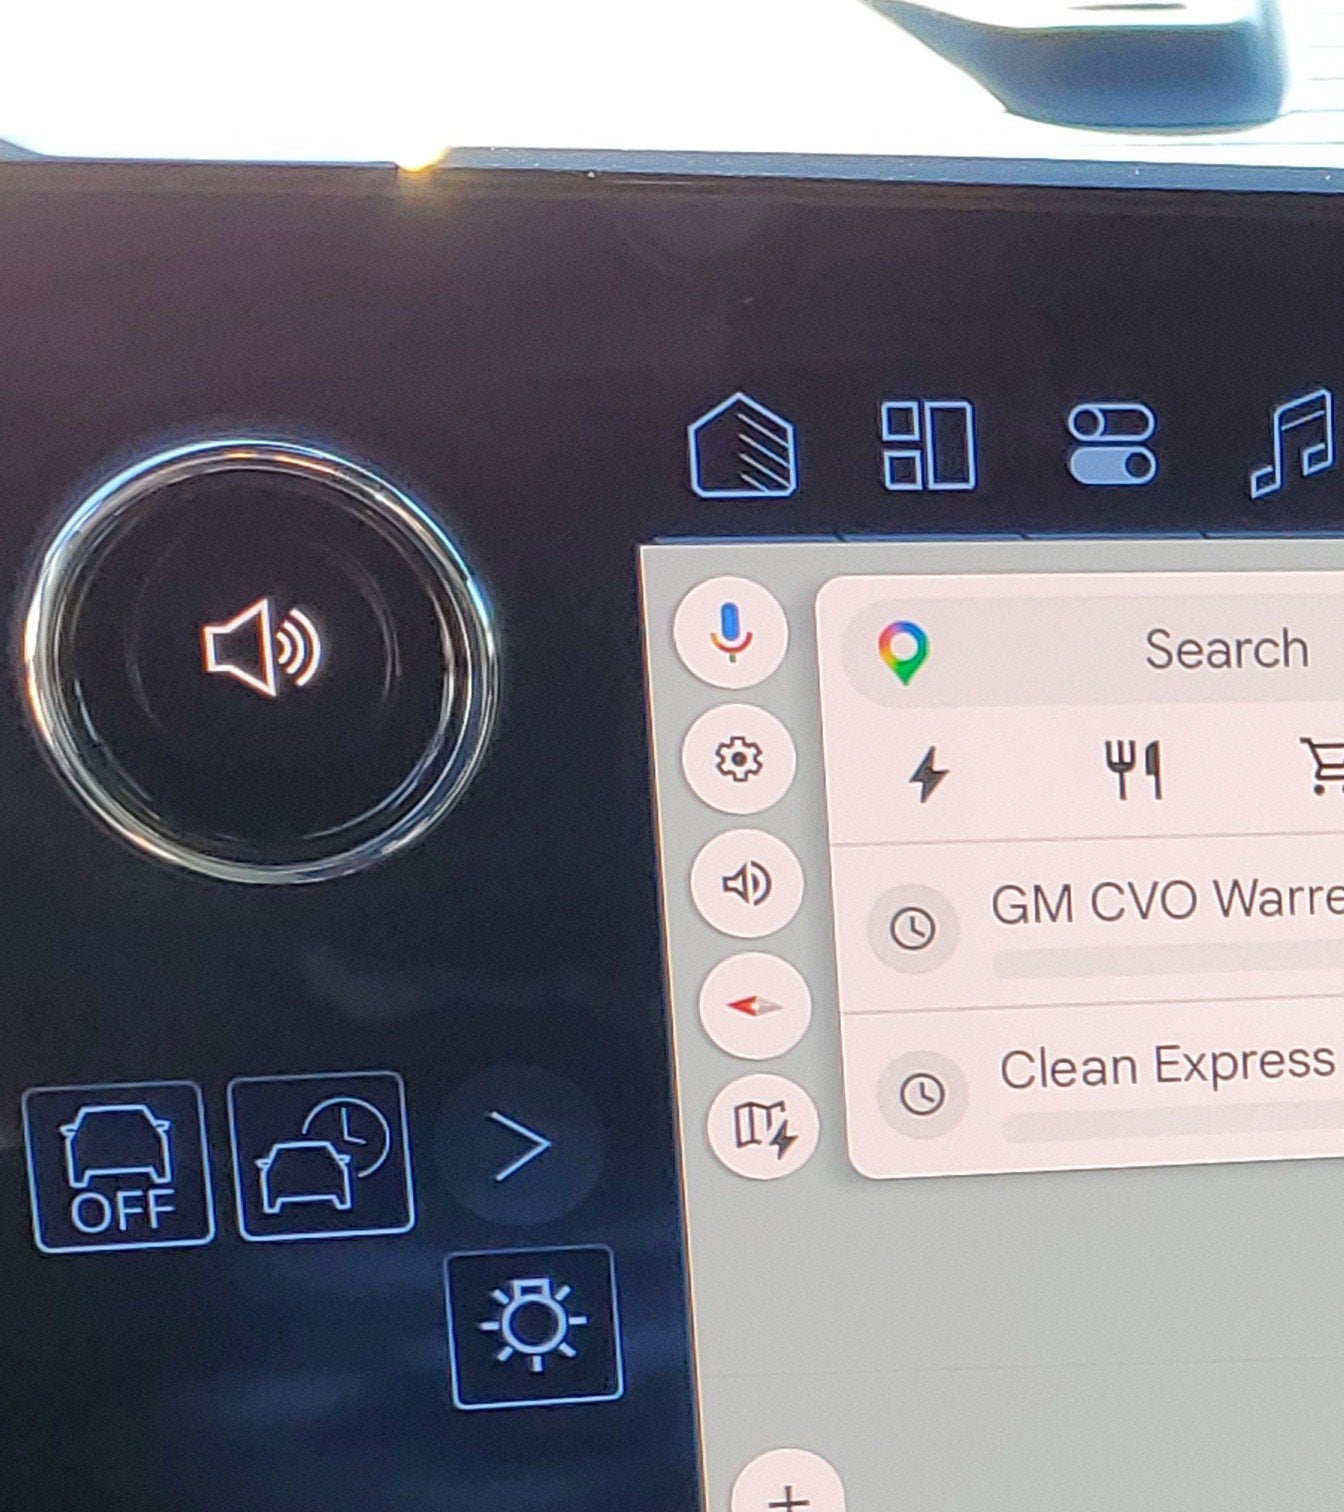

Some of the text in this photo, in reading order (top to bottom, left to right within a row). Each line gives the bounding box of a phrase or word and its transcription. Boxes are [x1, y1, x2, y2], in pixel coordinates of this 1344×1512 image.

[1145, 626, 1310, 670] Search
[991, 883, 1074, 925] GM
[1090, 878, 1198, 922] CVO
[1000, 1046, 1139, 1090] Clean
[1154, 1043, 1337, 1092] Express
[70, 1188, 176, 1234] OFF
